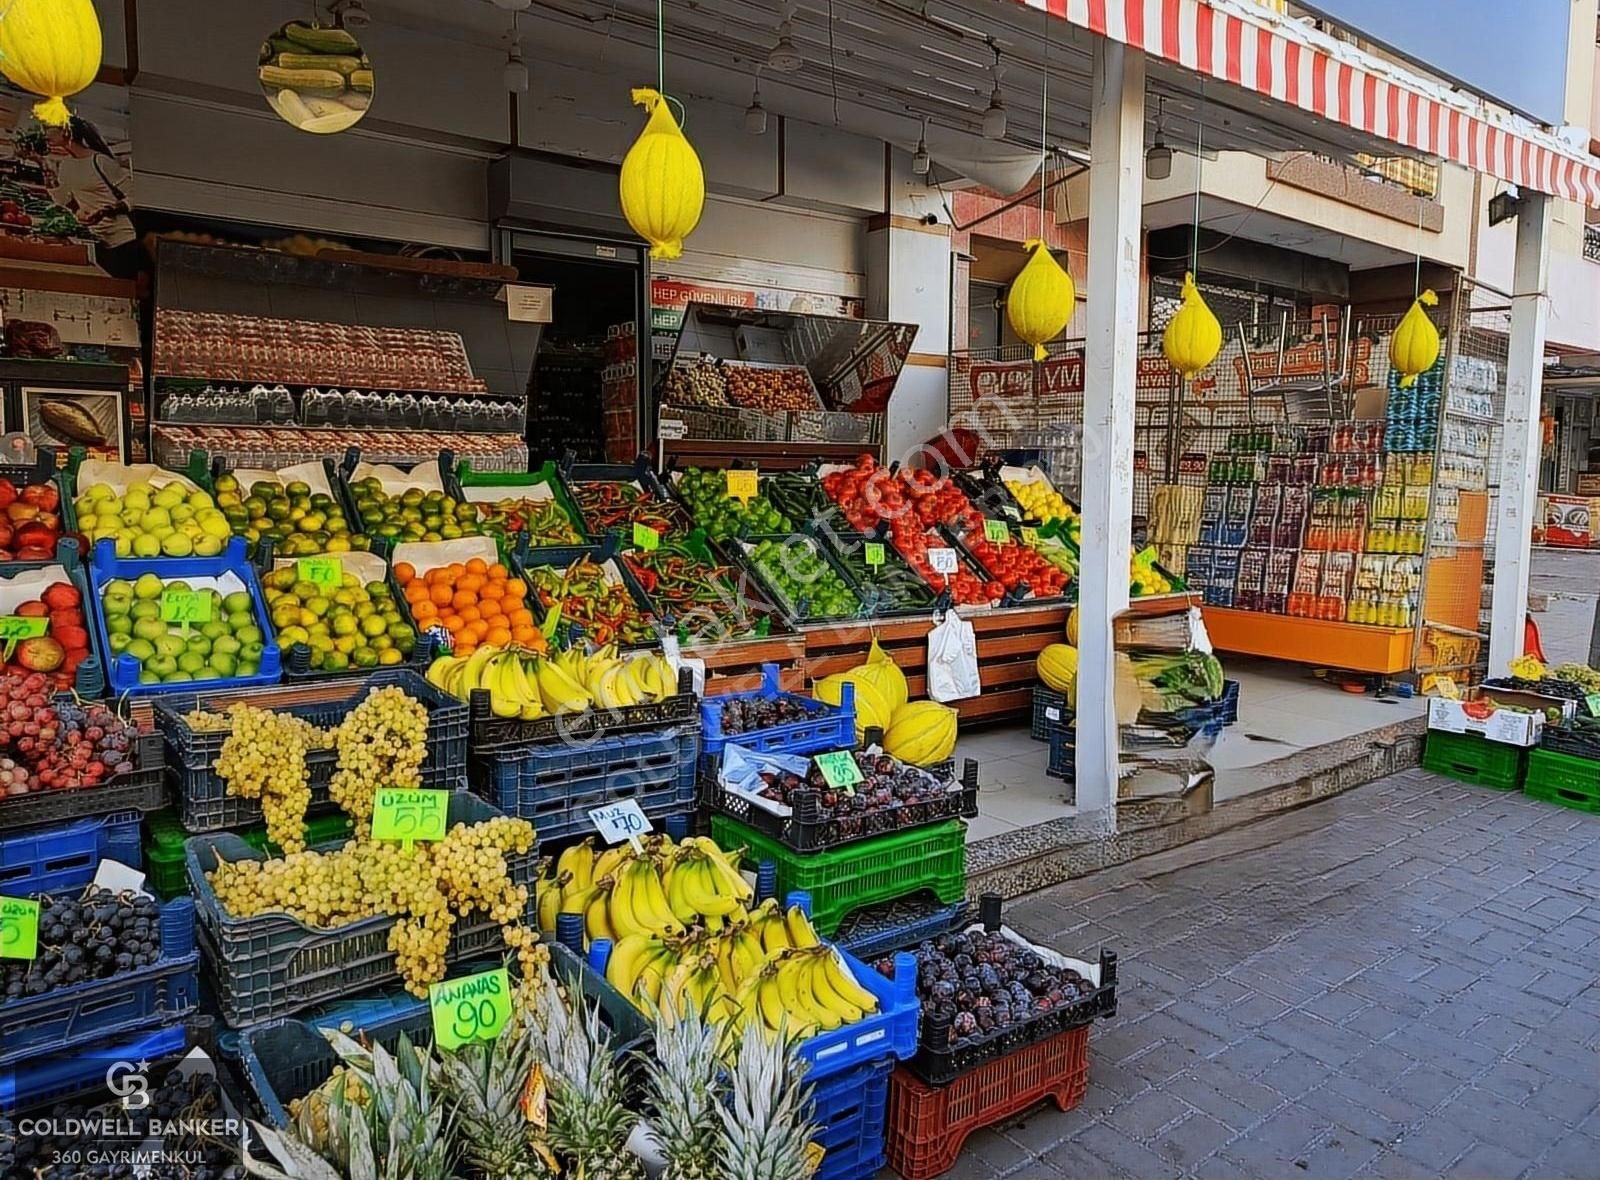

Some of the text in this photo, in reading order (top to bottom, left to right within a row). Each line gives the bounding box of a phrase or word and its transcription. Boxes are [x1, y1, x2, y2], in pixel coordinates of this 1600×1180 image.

[653, 288, 677, 299] HEP
[653, 314, 677, 326] HEP
[381, 791, 437, 809] ÜZÜM
[393, 806, 441, 835] 55
[434, 974, 501, 1007] ANANAS
[452, 998, 497, 1039] 90
